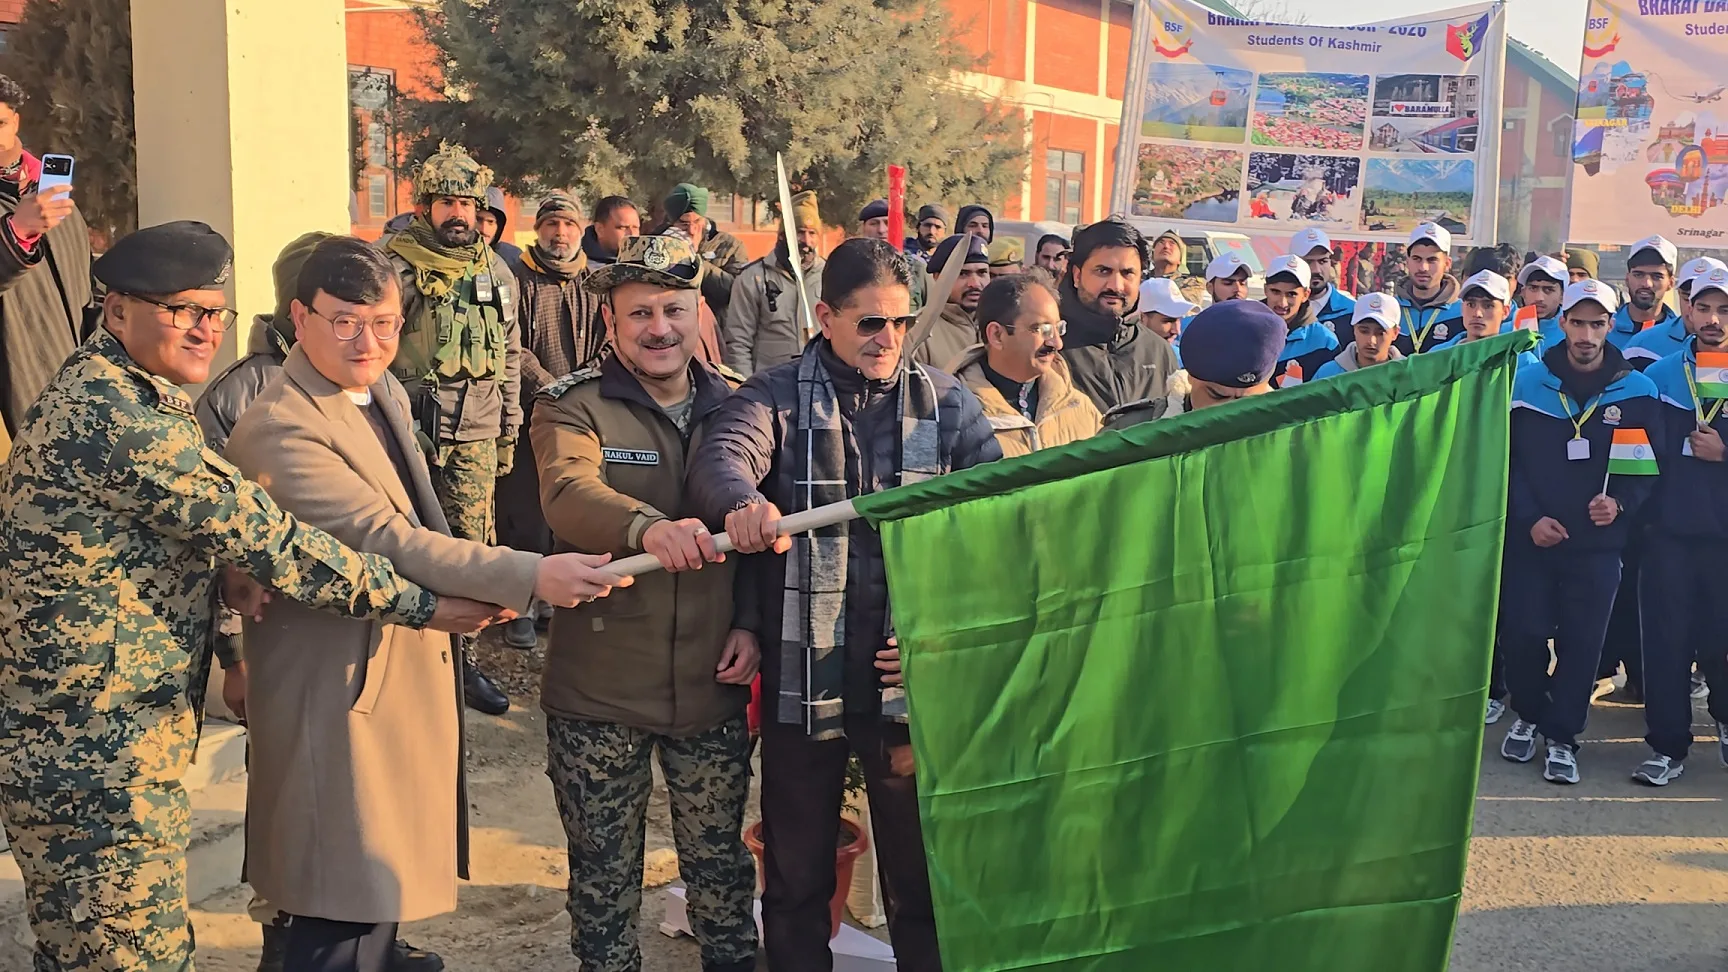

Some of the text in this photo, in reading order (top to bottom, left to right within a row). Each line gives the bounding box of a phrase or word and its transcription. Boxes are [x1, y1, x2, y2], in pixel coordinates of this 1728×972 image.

[1164, 21, 1183, 32] BSF
[1588, 17, 1609, 30] BSF
[1247, 34, 1382, 53] Students Of Kashmir
[1405, 105, 1449, 113] BARAMULLA
[1671, 205, 1702, 214] DELHI
[1677, 227, 1725, 239] Srinagar
[166, 395, 187, 408] BSF
[604, 450, 657, 461] NAKUL VAID
